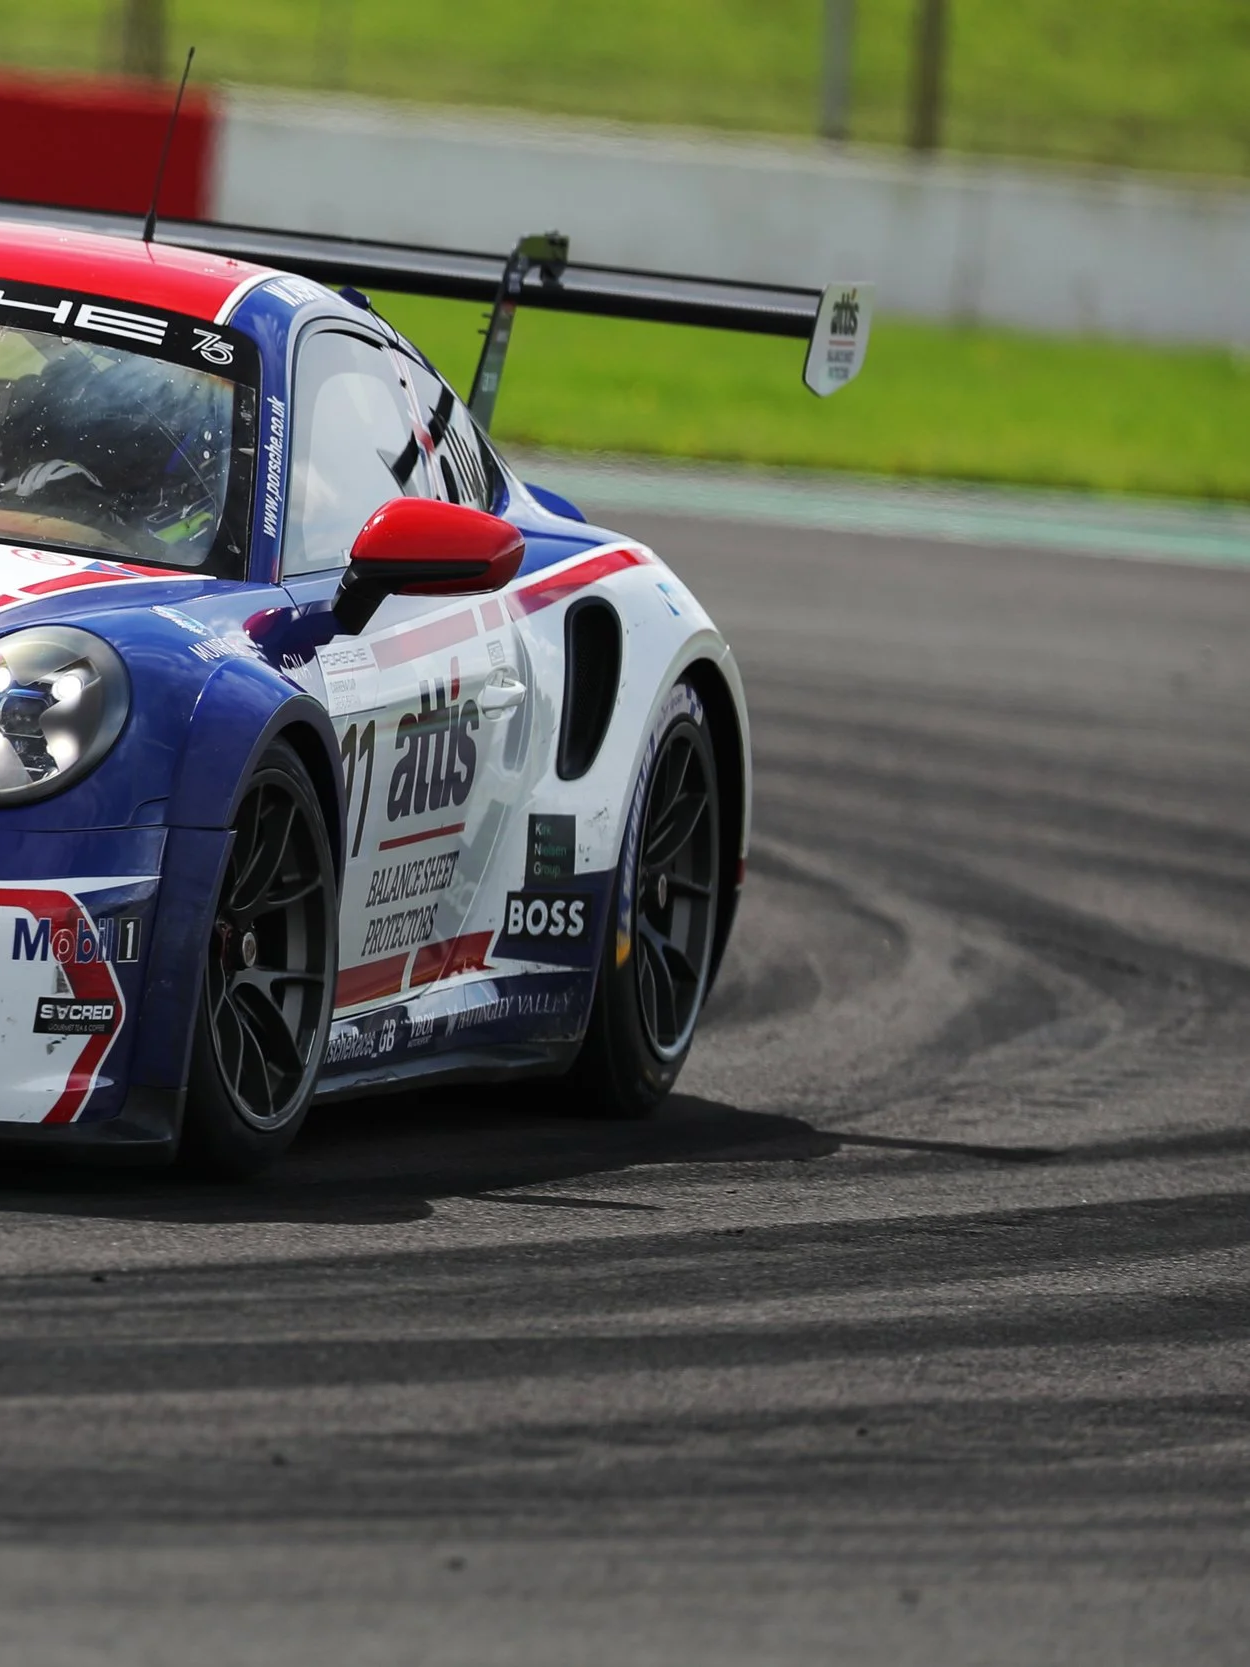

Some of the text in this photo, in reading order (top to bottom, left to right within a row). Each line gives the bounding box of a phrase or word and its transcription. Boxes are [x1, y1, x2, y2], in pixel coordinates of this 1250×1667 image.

[192, 328, 235, 365] 75
[263, 395, 286, 539] www.porsche.co.uk
[387, 656, 480, 823] attis
[341, 719, 376, 858] 11
[533, 861, 561, 879] Group
[534, 842, 567, 857] Nielsen
[365, 850, 460, 908] BALANCE SHEET
[12, 917, 114, 964] Mobil
[361, 902, 438, 957] PROTECTORS
[508, 899, 585, 936] BOSS
